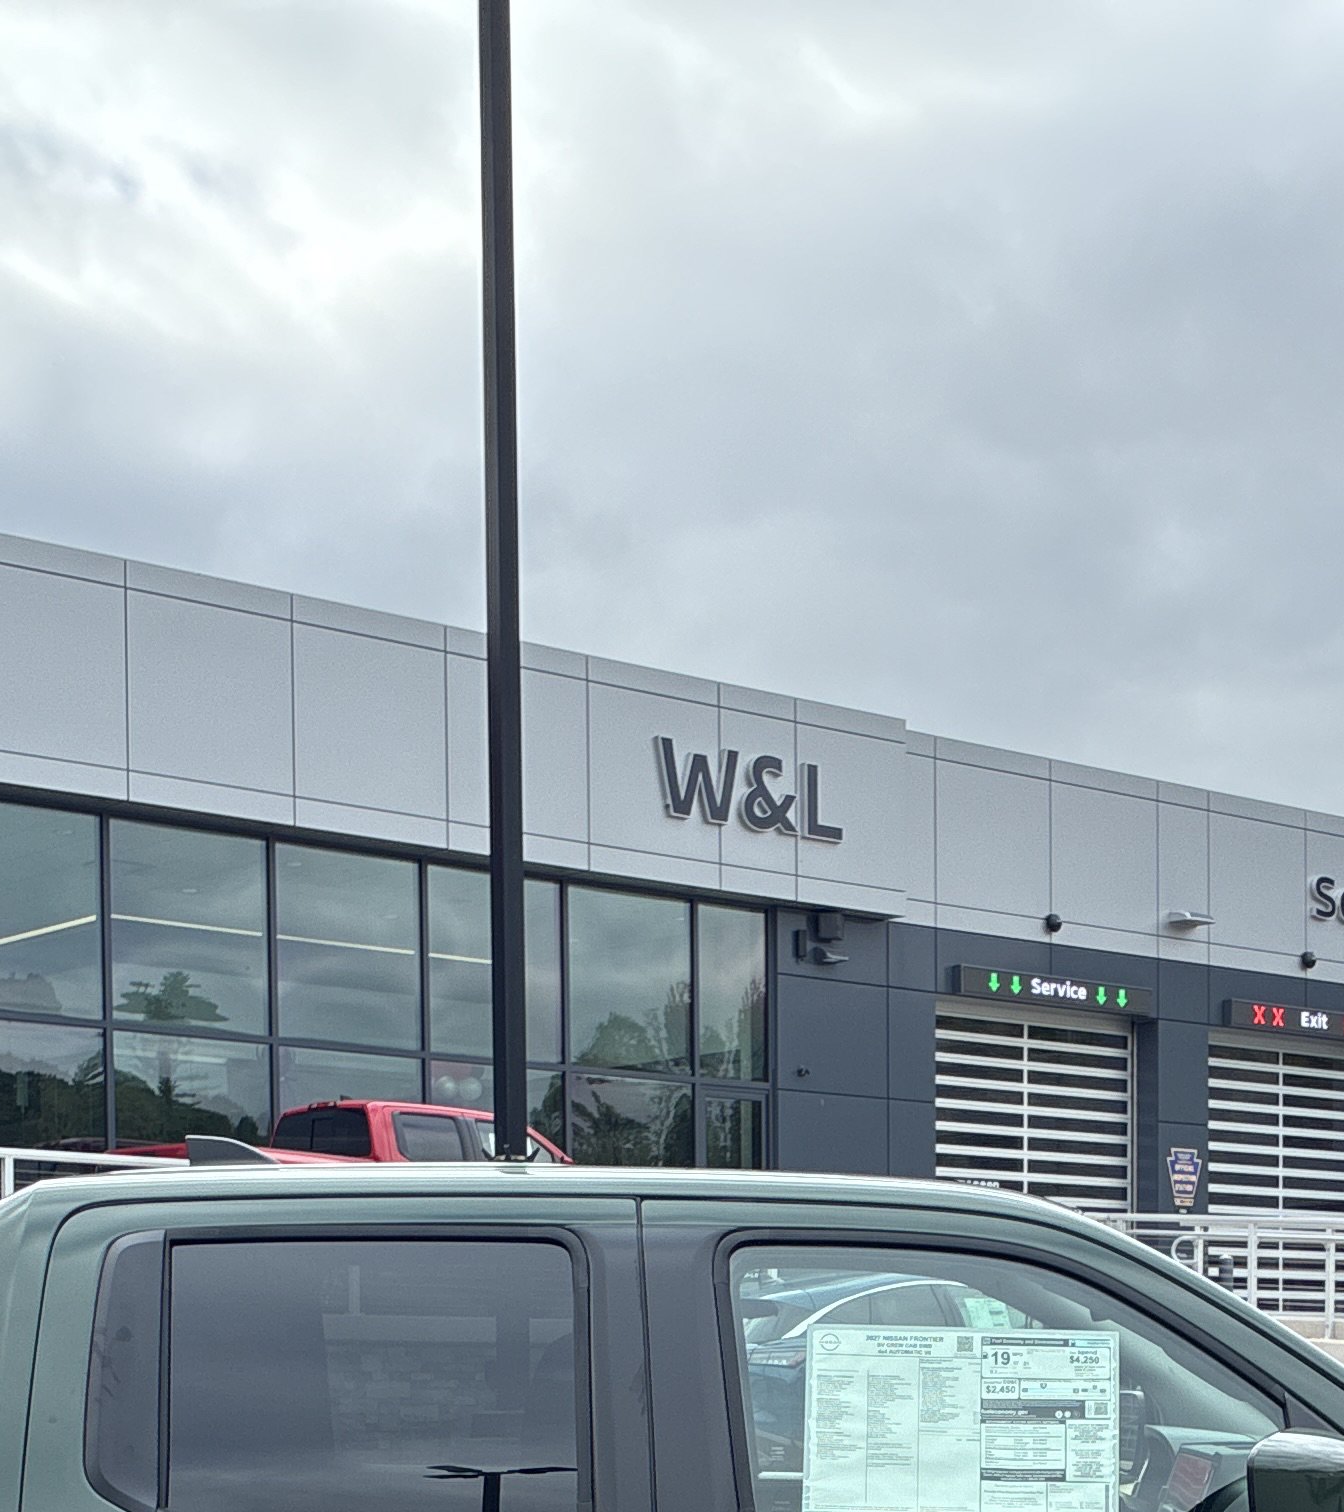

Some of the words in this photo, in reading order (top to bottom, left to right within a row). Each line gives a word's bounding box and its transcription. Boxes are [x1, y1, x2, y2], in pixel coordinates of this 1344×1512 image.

[653, 735, 843, 843] W&L
[1030, 977, 1088, 1001] Service
[1300, 1011, 1329, 1030] Exit
[991, 1350, 1011, 1366] 19
[985, 1385, 1016, 1394] $2,450
